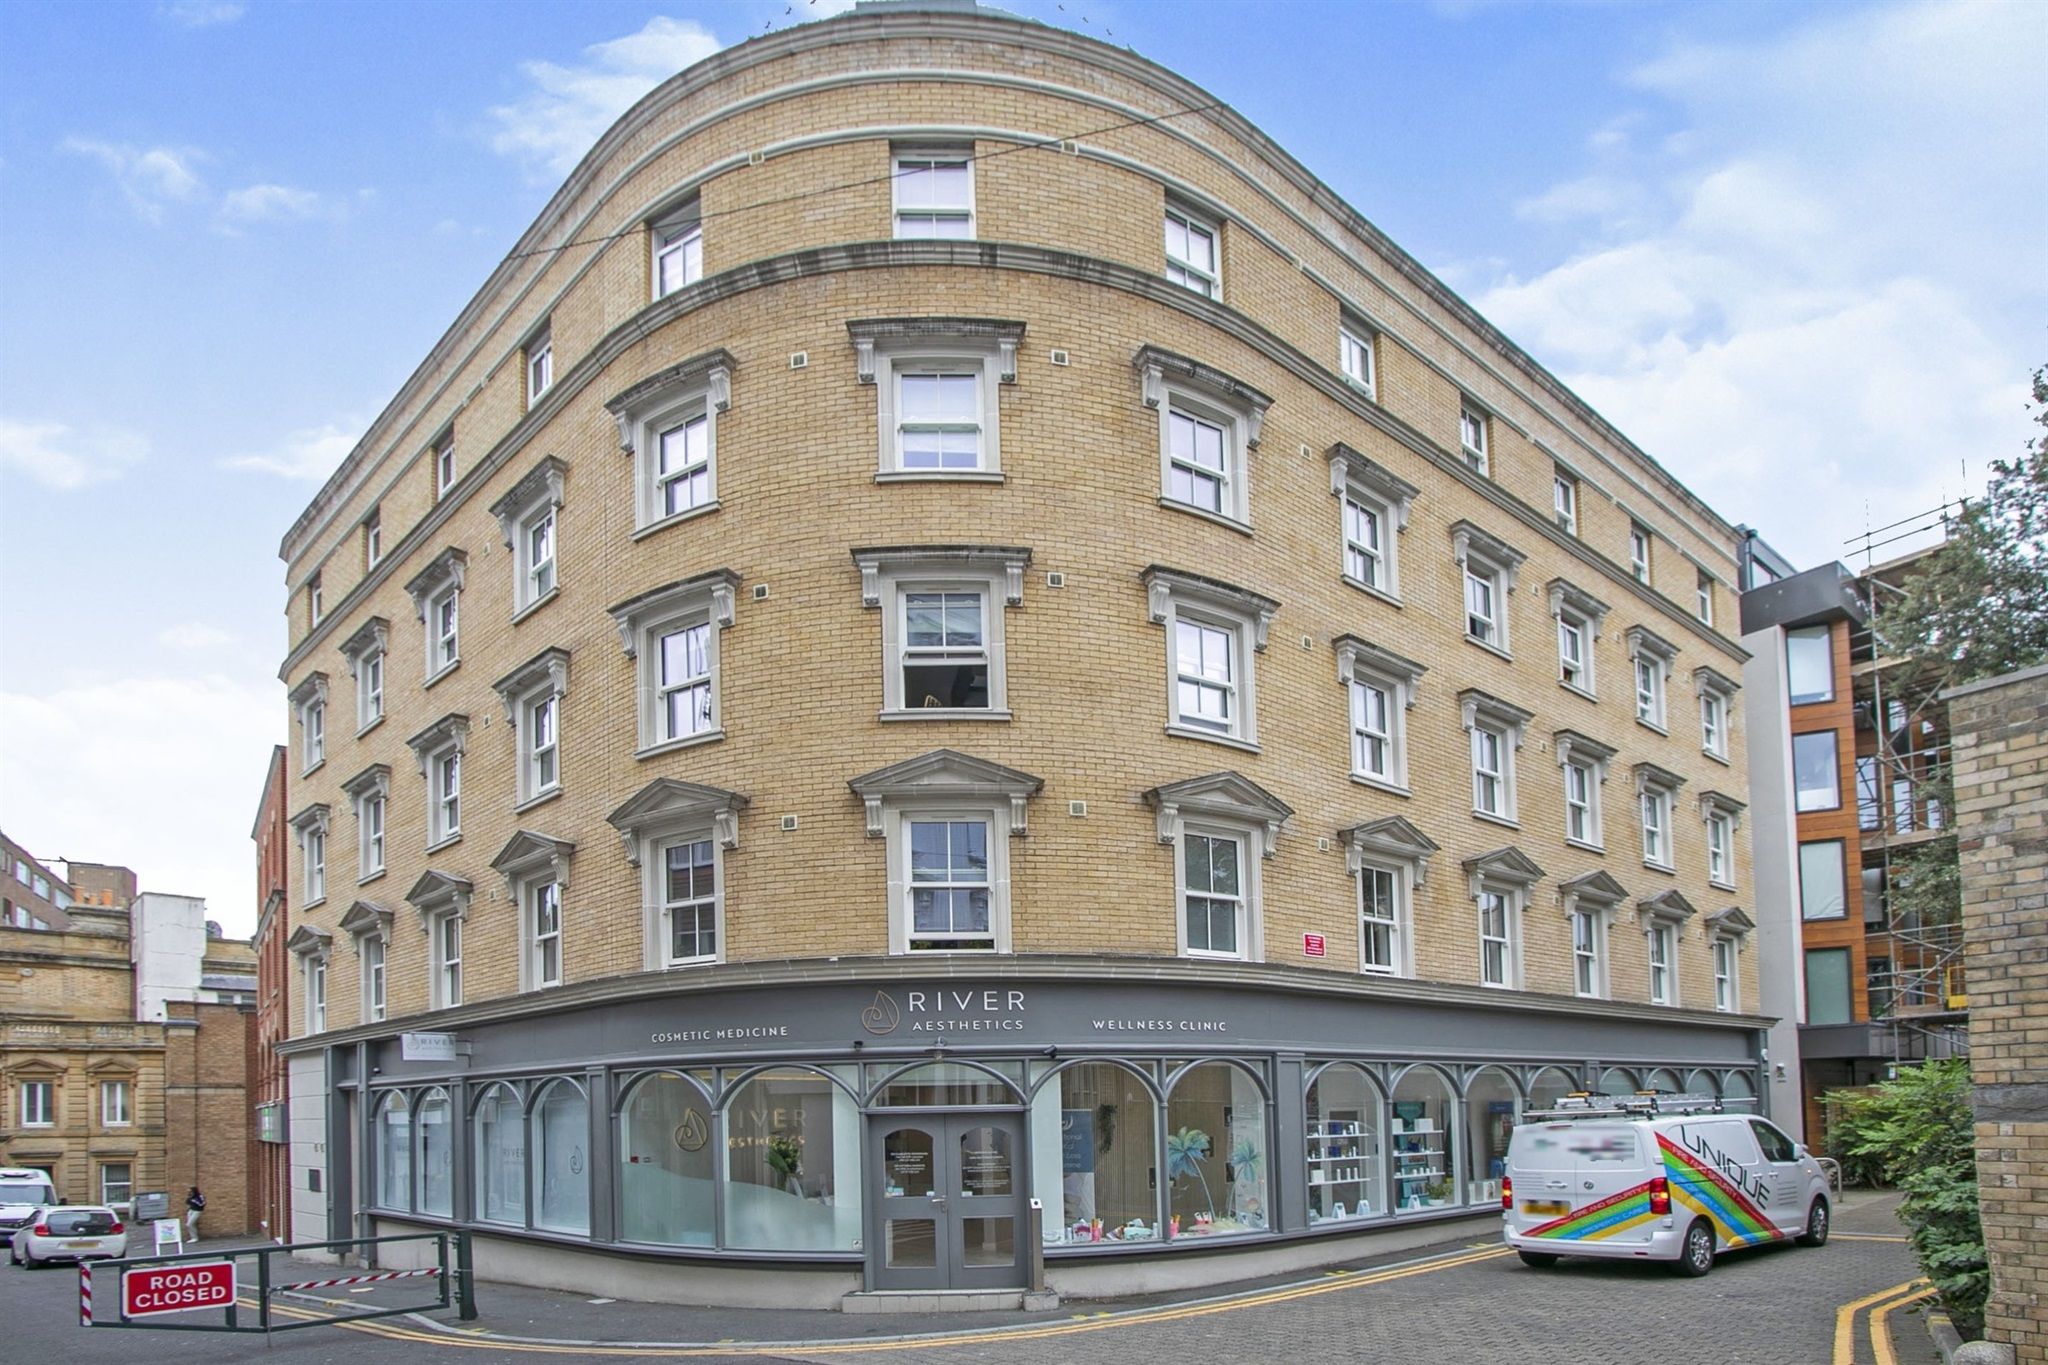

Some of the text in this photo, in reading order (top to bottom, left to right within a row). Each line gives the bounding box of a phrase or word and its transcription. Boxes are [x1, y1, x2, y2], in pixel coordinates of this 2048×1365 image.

[908, 991, 1025, 1012] RIVER
[651, 1026, 788, 1043] COSMETIC MEDICINE
[912, 1020, 1024, 1031] AESTHETICS
[1092, 1020, 1227, 1031] WELLNESS CLINIC
[1680, 1124, 1771, 1211] UNIQUE
[1606, 1188, 1642, 1206] SECURITY
[150, 1271, 213, 1290] ROAD
[135, 1286, 226, 1307] CLOSED
